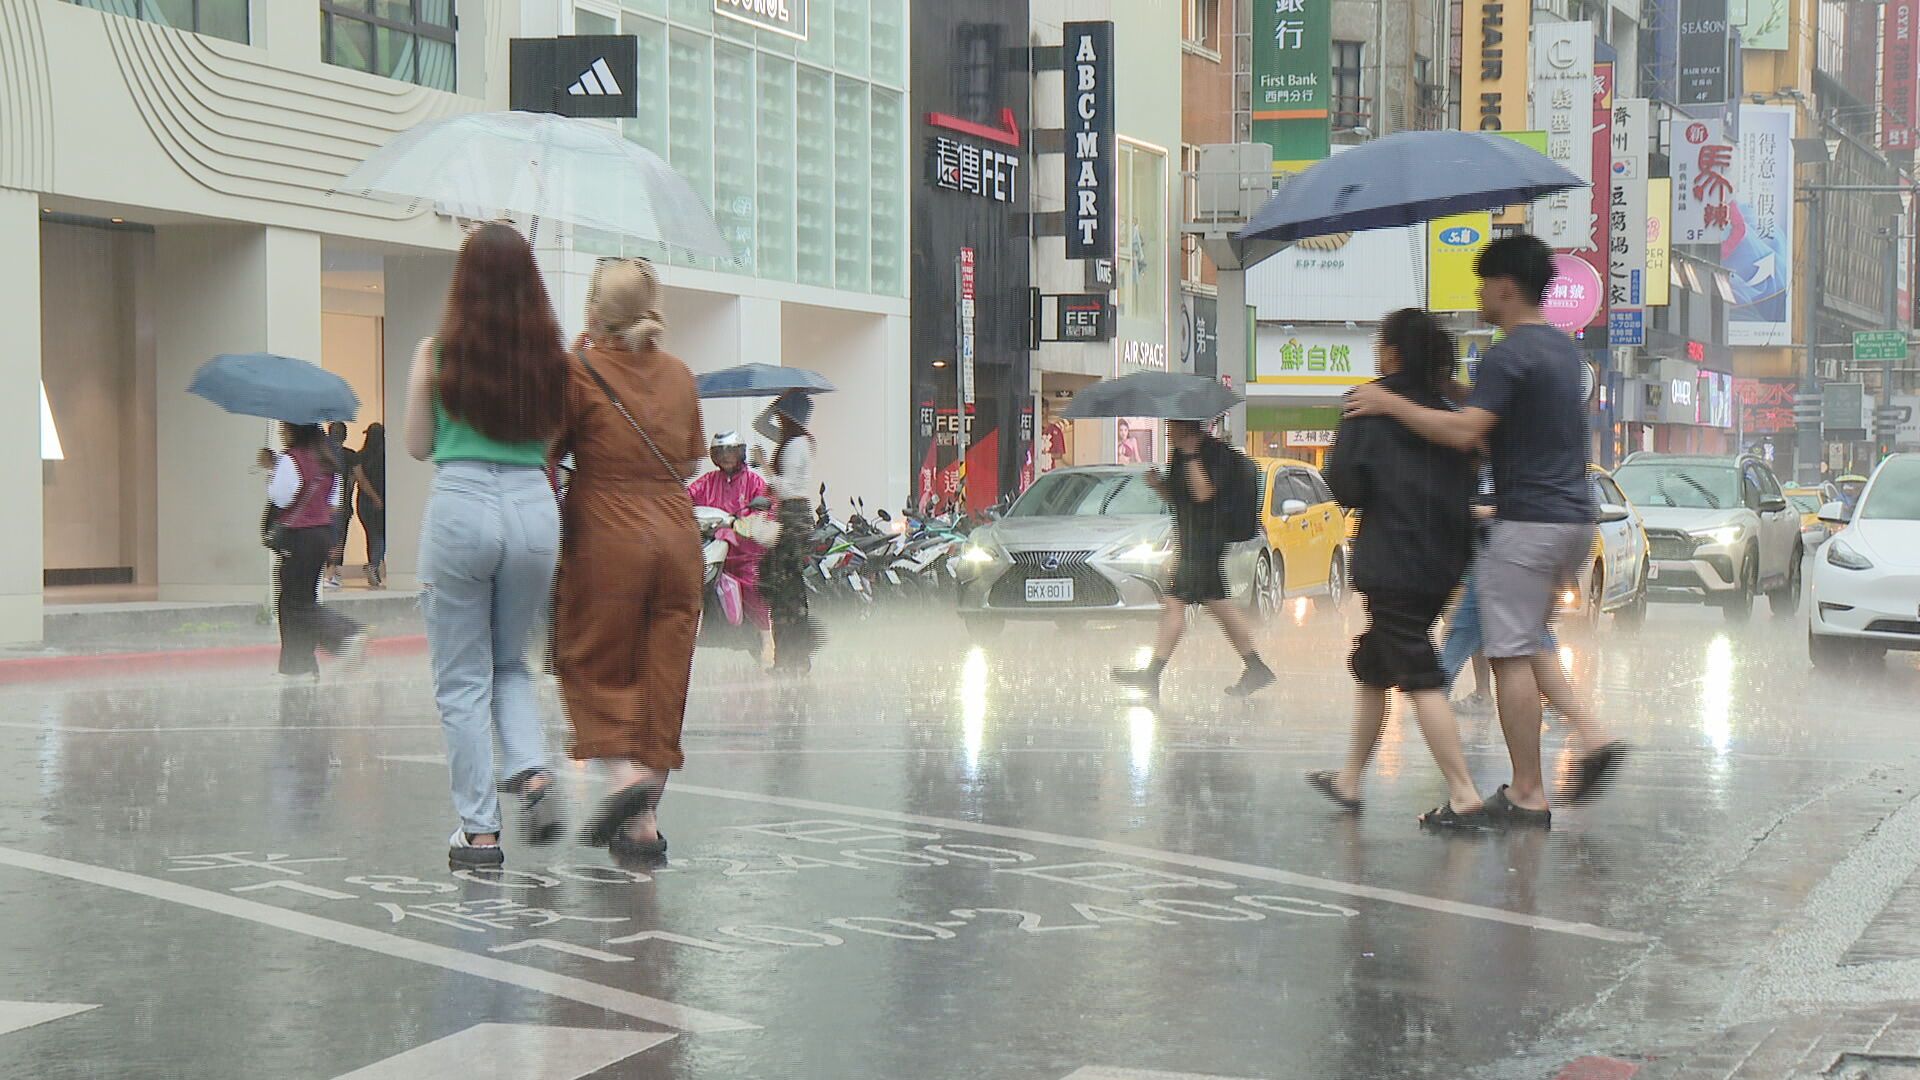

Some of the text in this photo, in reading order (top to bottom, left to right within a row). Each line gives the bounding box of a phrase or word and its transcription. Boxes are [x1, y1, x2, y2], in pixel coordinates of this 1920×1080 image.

[1681, 20, 1725, 34] SEASON
[1481, 4, 1503, 81] HAIR
[1260, 72, 1317, 87] First Bank
[1265, 89, 1313, 103] 西門分行
[1075, 35, 1098, 245] ABC-MART
[1690, 125, 1704, 142] 新
[1095, 258, 1112, 284] VANS
[1065, 311, 1100, 325] FET
[1124, 340, 1164, 367] AIR SPACE
[1279, 344, 1351, 371] 鮮自然
[921, 408, 934, 423] FET
[936, 415, 975, 432] FET
[1021, 414, 1032, 429] FET
[489, 894, 1361, 962] 1100-2400
